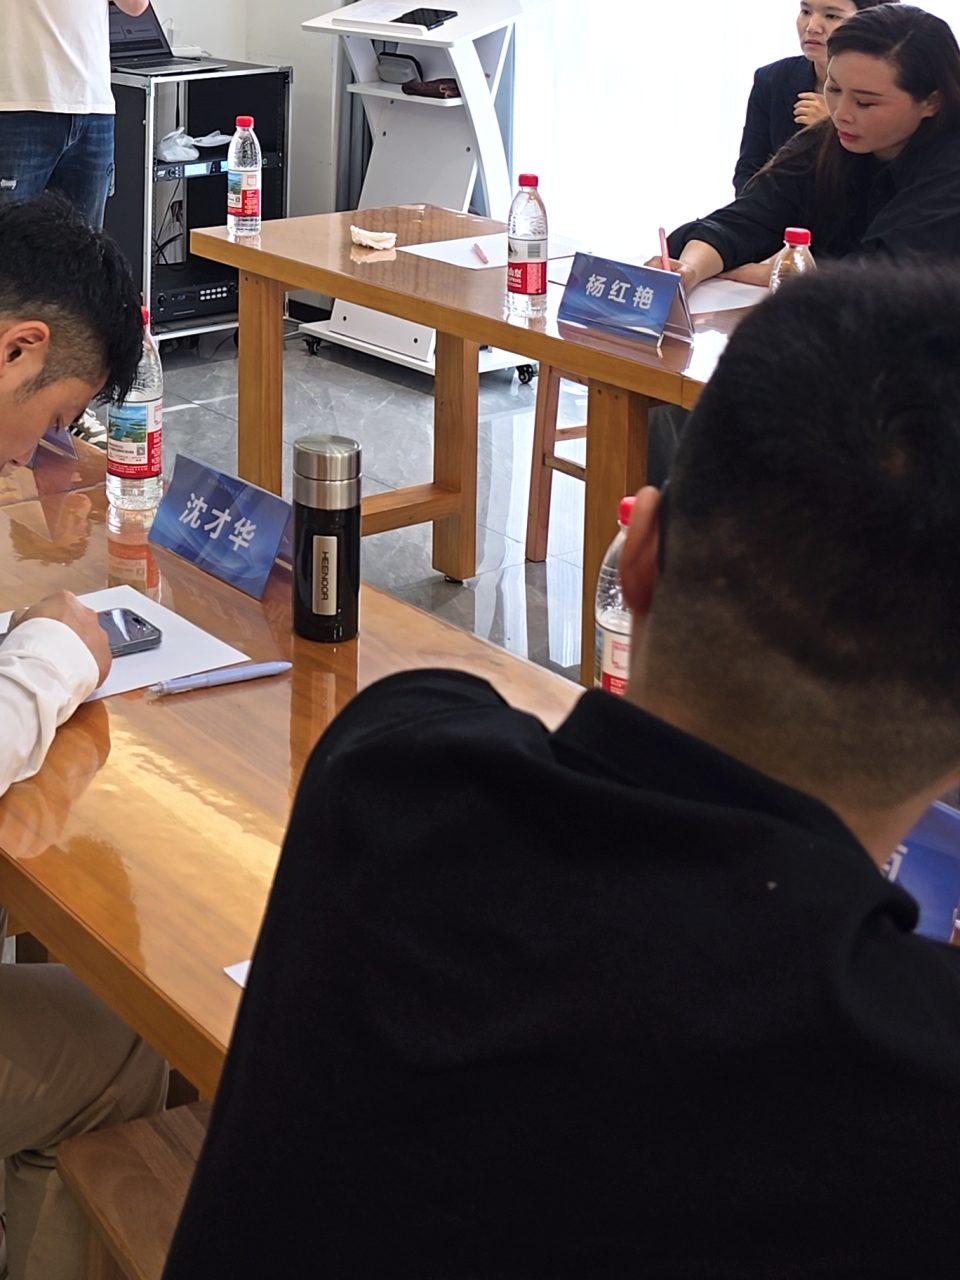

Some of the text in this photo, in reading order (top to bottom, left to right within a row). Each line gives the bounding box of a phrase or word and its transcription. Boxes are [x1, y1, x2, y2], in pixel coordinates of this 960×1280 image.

[586, 273, 654, 310] 杨红艳
[179, 492, 257, 552] 沈才华
